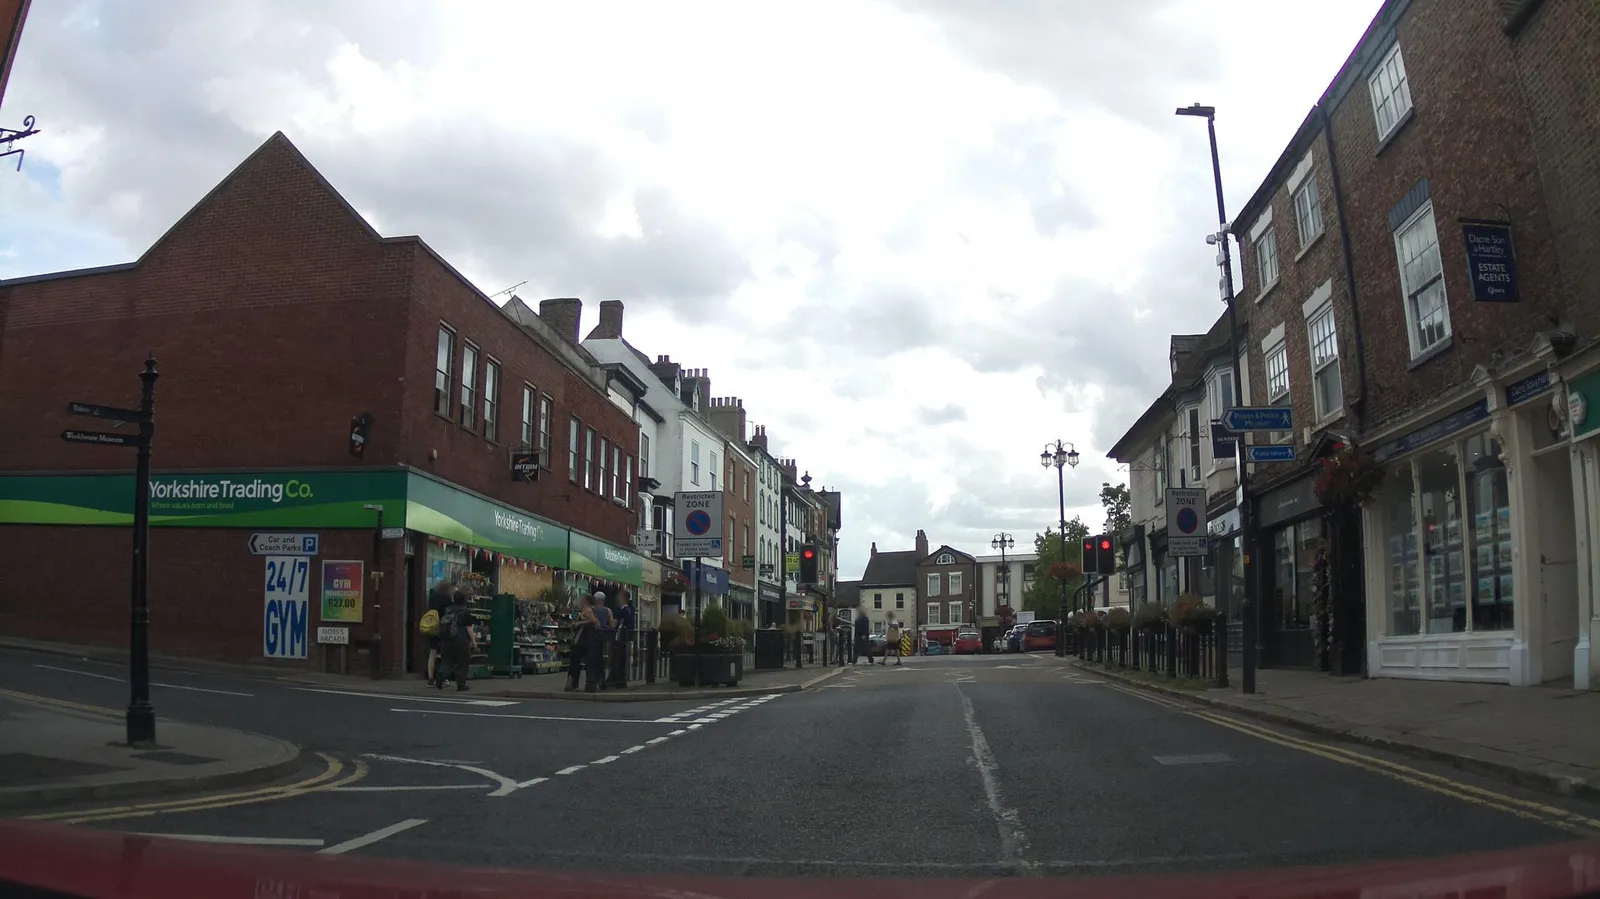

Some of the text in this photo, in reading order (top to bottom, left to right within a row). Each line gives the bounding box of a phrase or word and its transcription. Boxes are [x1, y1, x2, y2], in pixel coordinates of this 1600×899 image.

[1468, 234, 1505, 244] Dacre Son
[1478, 244, 1504, 255] Hartley
[1478, 263, 1507, 272] ESTATE
[1478, 274, 1510, 282] AGENTS
[66, 432, 124, 443] Workhouse Museum
[149, 479, 314, 502] Yorkshire Trading Co.
[494, 510, 519, 531] Yorkshire
[519, 519, 537, 542] Trading
[266, 559, 308, 595] 24/7
[333, 579, 351, 589] GYM
[328, 599, 355, 608] £27.00
[265, 599, 307, 657] GYM
